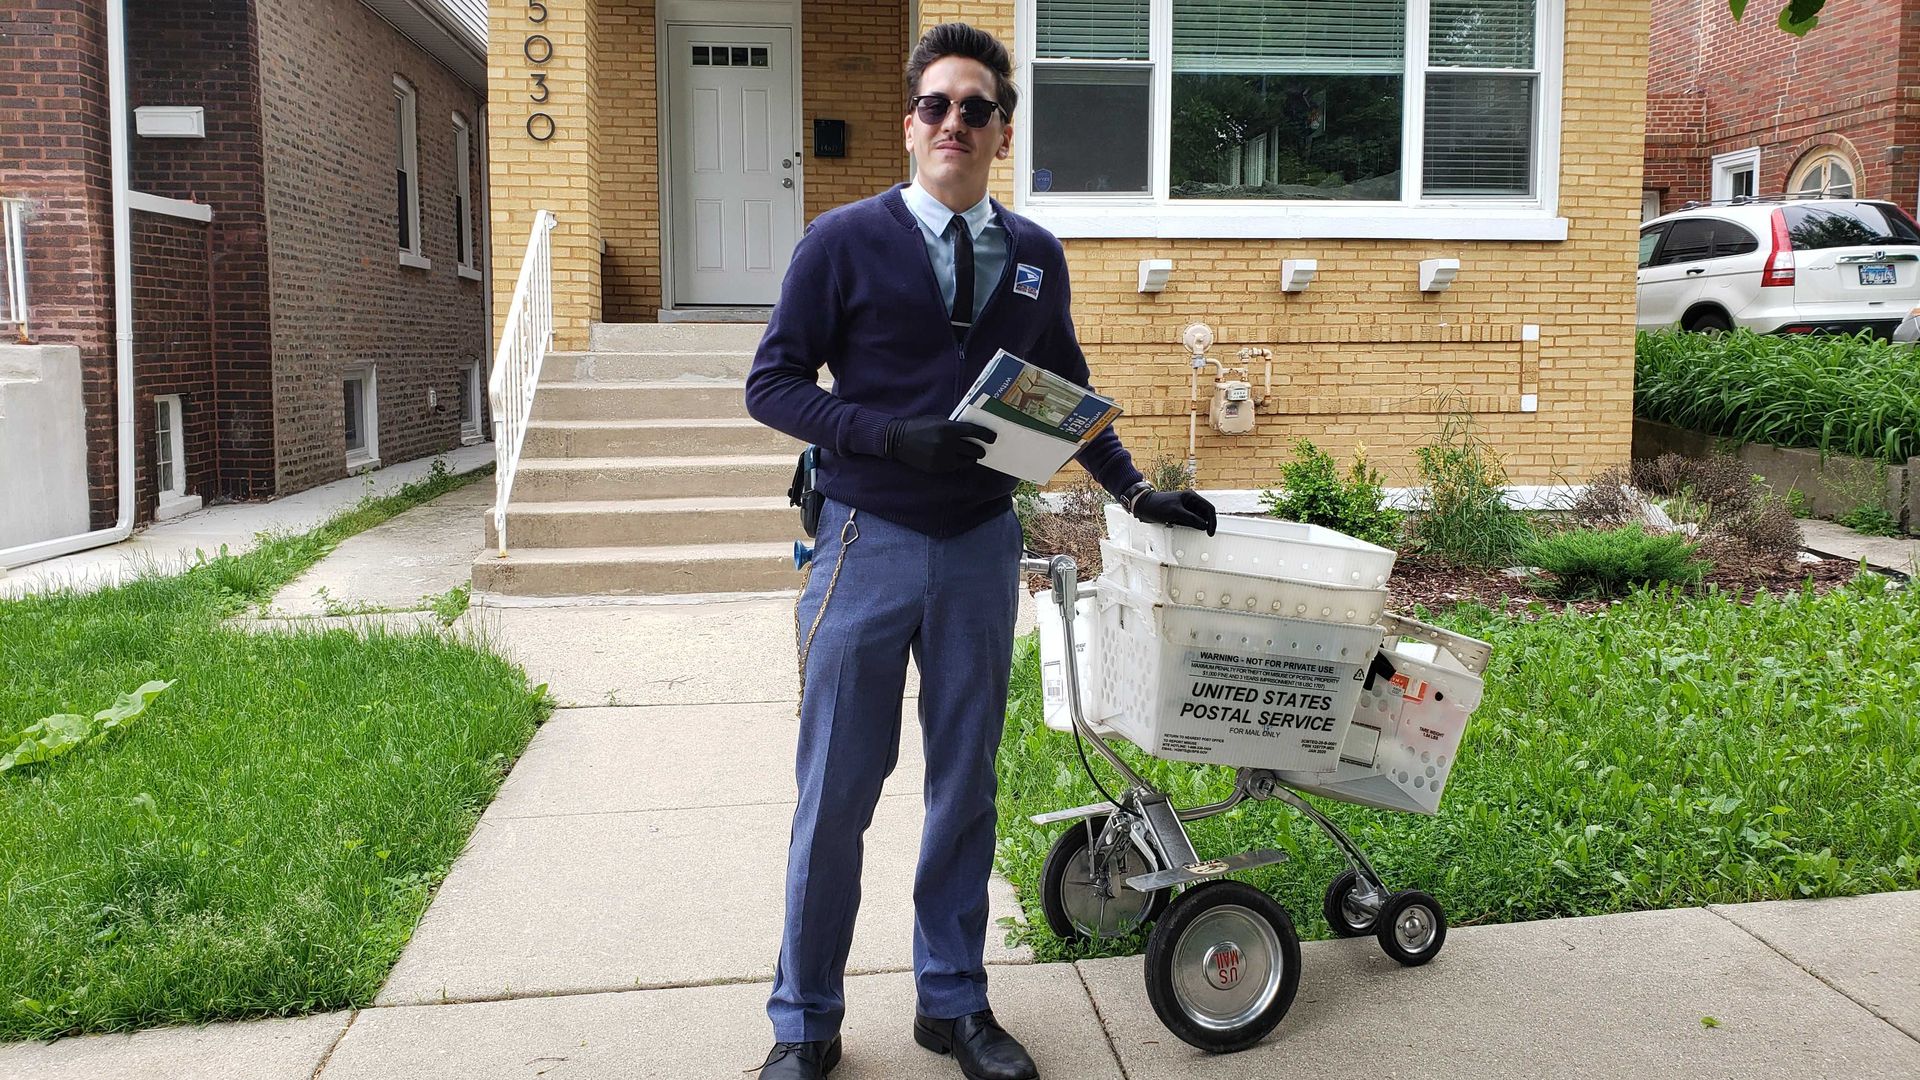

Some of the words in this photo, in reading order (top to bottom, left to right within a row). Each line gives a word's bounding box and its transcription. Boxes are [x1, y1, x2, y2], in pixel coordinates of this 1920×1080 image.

[524, 0, 556, 141] 5030
[1191, 662, 1215, 670] MAXIMUM
[1215, 665, 1235, 673] PENALTY
[1270, 671, 1288, 679] MISUSE
[1200, 651, 1240, 663] WARNING
[1246, 657, 1263, 666] NOT
[1264, 659, 1282, 668] FOR
[1283, 661, 1317, 672] PRIVATE
[1318, 665, 1335, 674] USE
[1260, 676, 1295, 686] IMPRISONMENT
[1191, 682, 1259, 703] UNITED
[1262, 690, 1332, 711] STATES
[1180, 702, 1252, 724] POSTAL
[1257, 710, 1336, 732] SERVICE
[1229, 727, 1244, 735] FOR
[1244, 728, 1261, 737] MAIL
[1262, 730, 1281, 739] ONLY
[1215, 949, 1239, 969] MAIL
[1219, 967, 1238, 984] US
